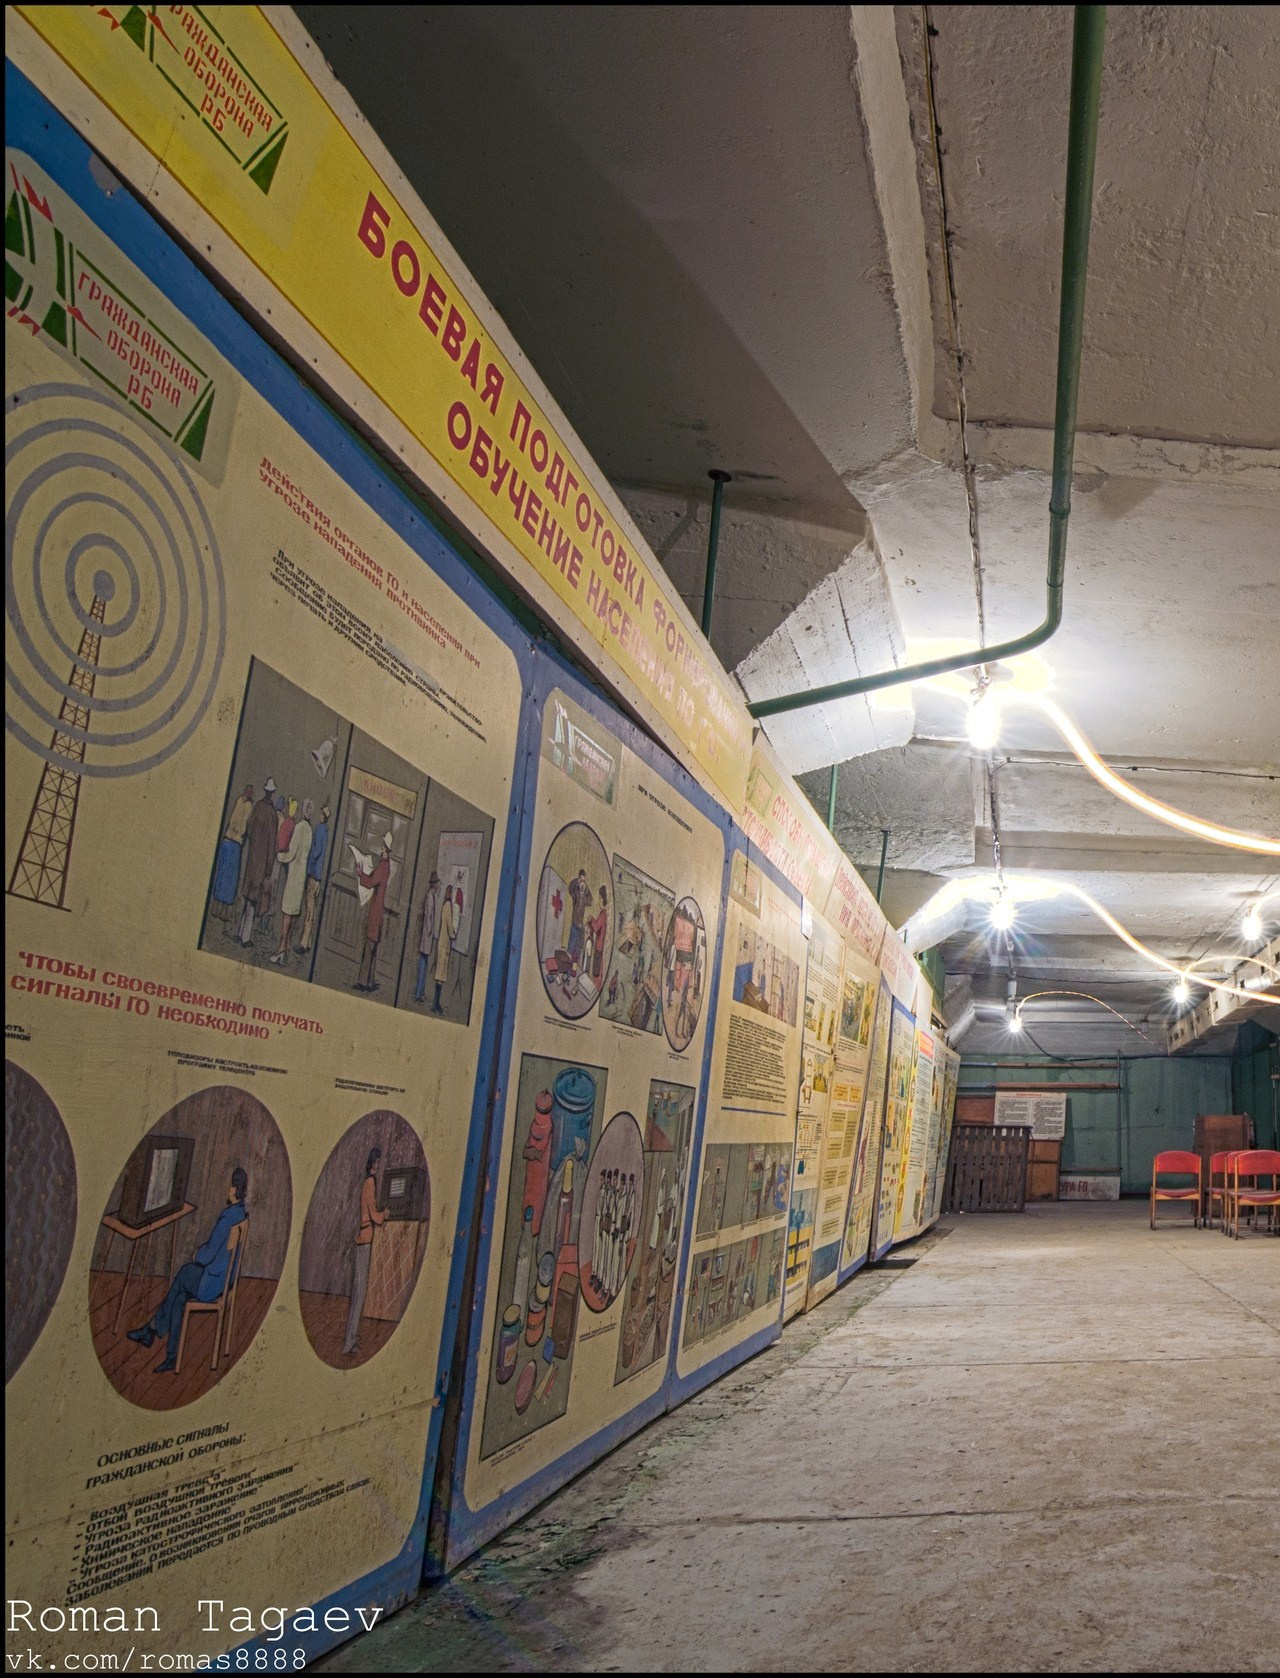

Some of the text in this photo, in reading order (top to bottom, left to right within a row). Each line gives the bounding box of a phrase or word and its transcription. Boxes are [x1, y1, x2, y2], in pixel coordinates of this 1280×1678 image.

[184, 46, 255, 139] ОБОРОНА
[200, 93, 227, 132] РБ
[78, 271, 199, 396] ГРАЖДАНСКАЯ
[107, 330, 181, 408] ОБОРОНА
[127, 374, 154, 410] РБ
[357, 189, 505, 416] БОЕВАЯ
[509, 397, 646, 613] ПОДГОТОВКА
[447, 402, 584, 590] ОБУЧЕНИЕ
[387, 572, 399, 591] ГО
[126, 996, 150, 1016] ГО
